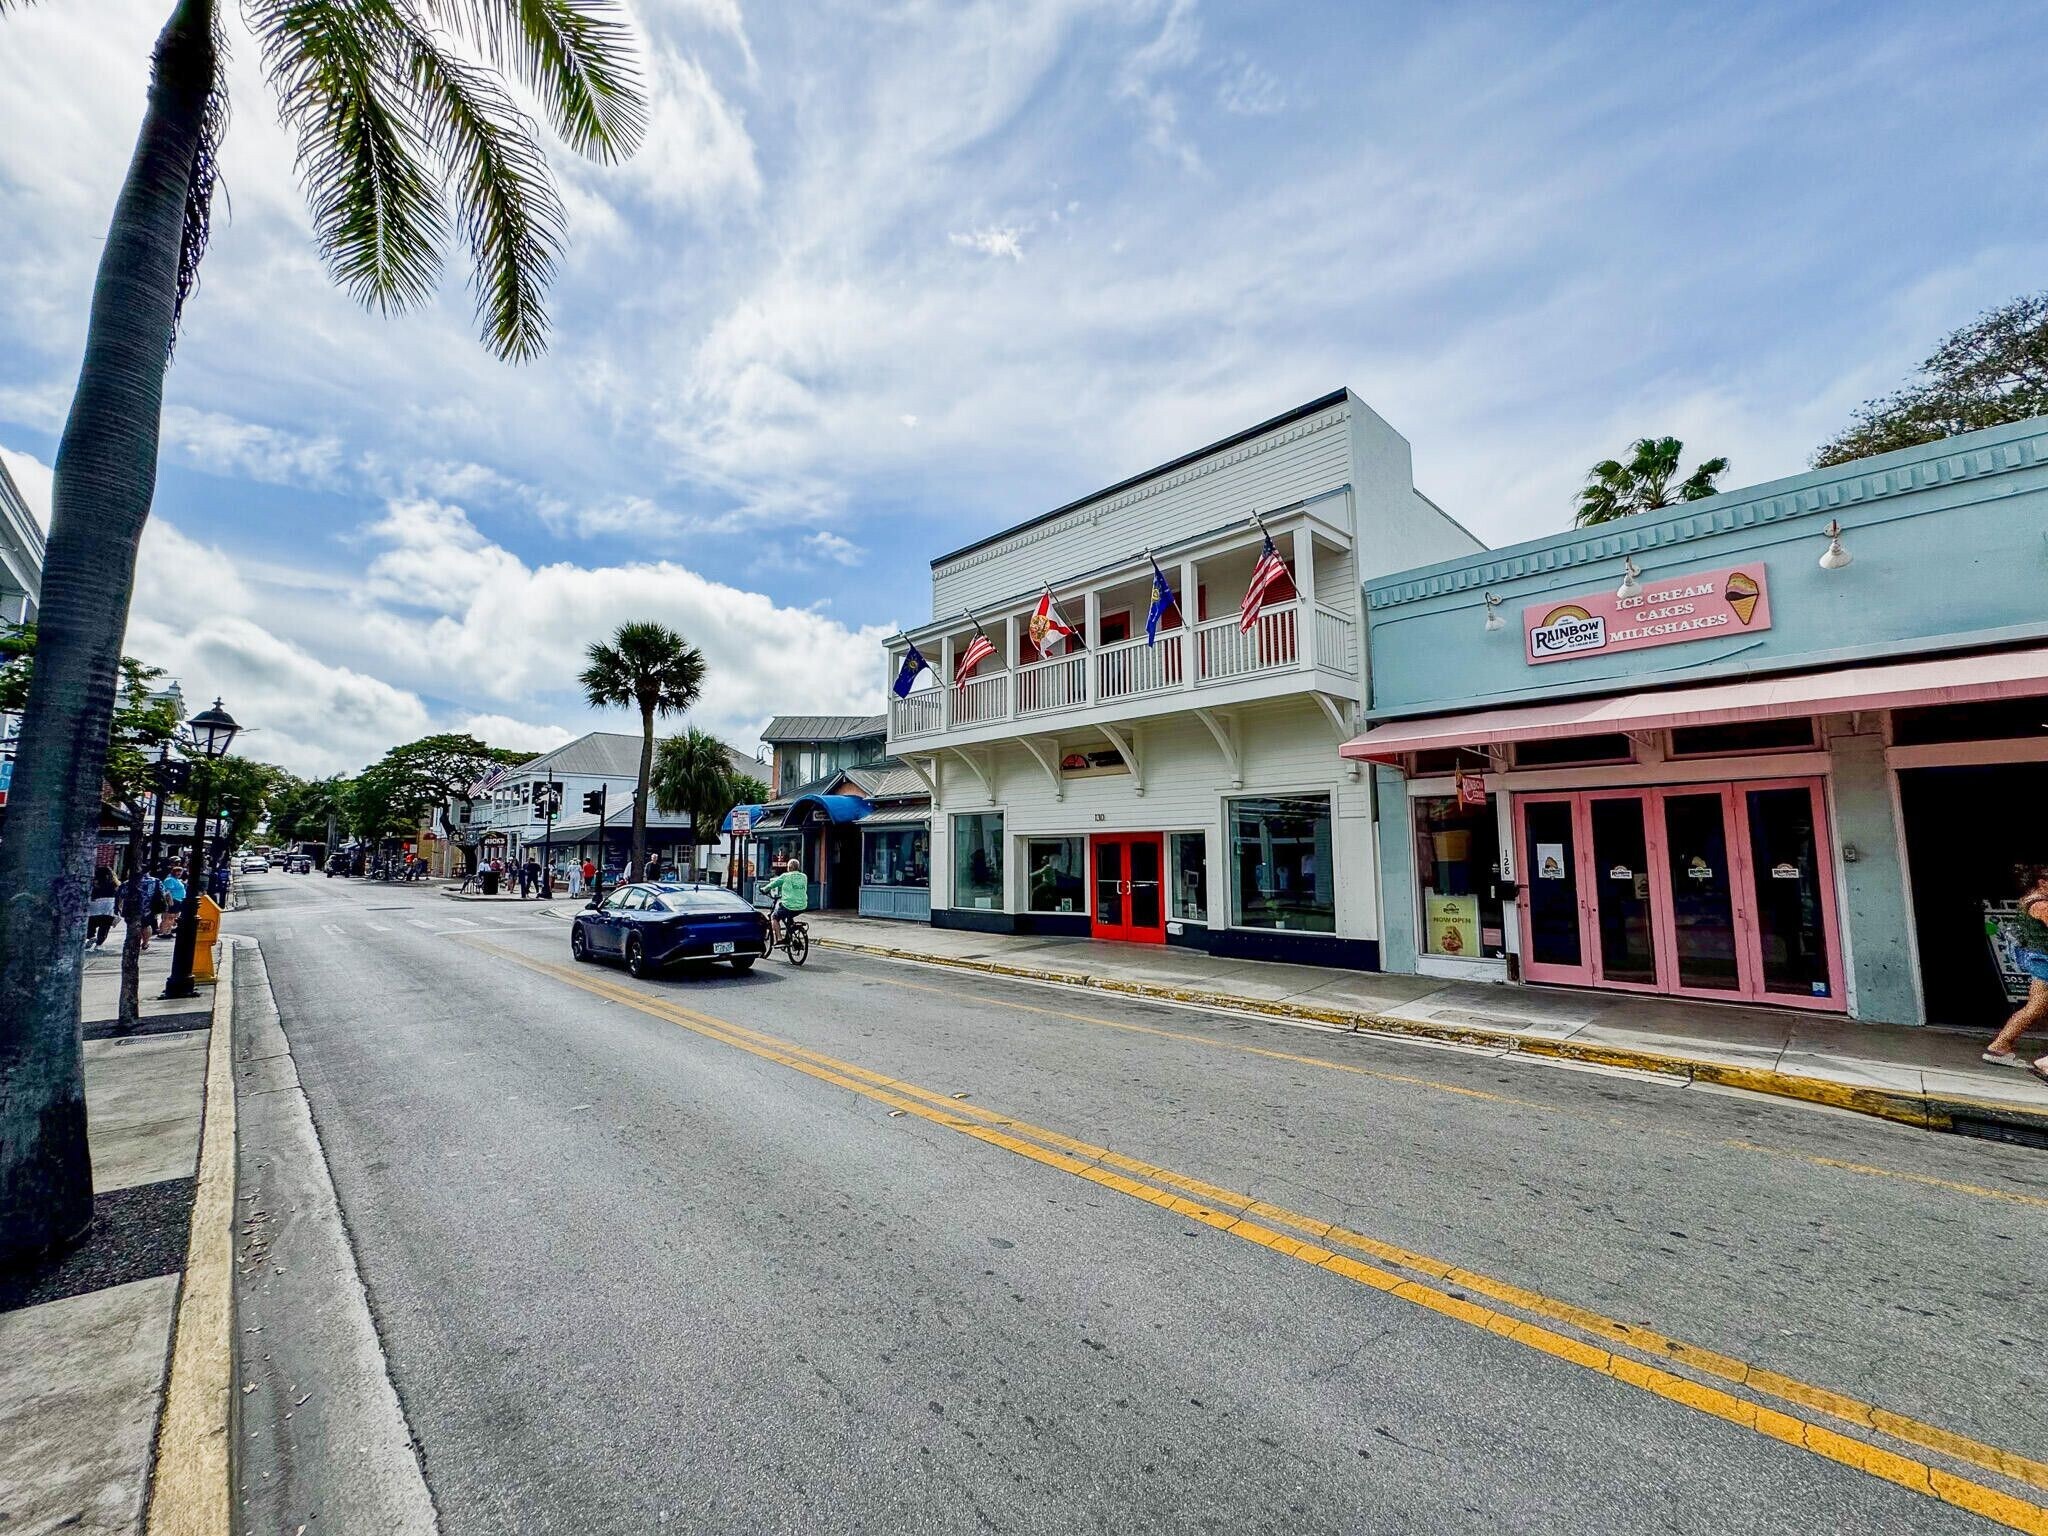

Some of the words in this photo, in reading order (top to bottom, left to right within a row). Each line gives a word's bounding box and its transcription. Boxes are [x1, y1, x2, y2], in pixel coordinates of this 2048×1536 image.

[1616, 596, 1644, 610] ICE
[1647, 583, 1714, 604] CREAM
[1636, 603, 1695, 622] CAKES
[1536, 621, 1599, 650] RAINBOW
[1568, 632, 1599, 643] CONE
[1609, 614, 1728, 642] MILKSHAKES
[1503, 849, 1511, 875] 128
